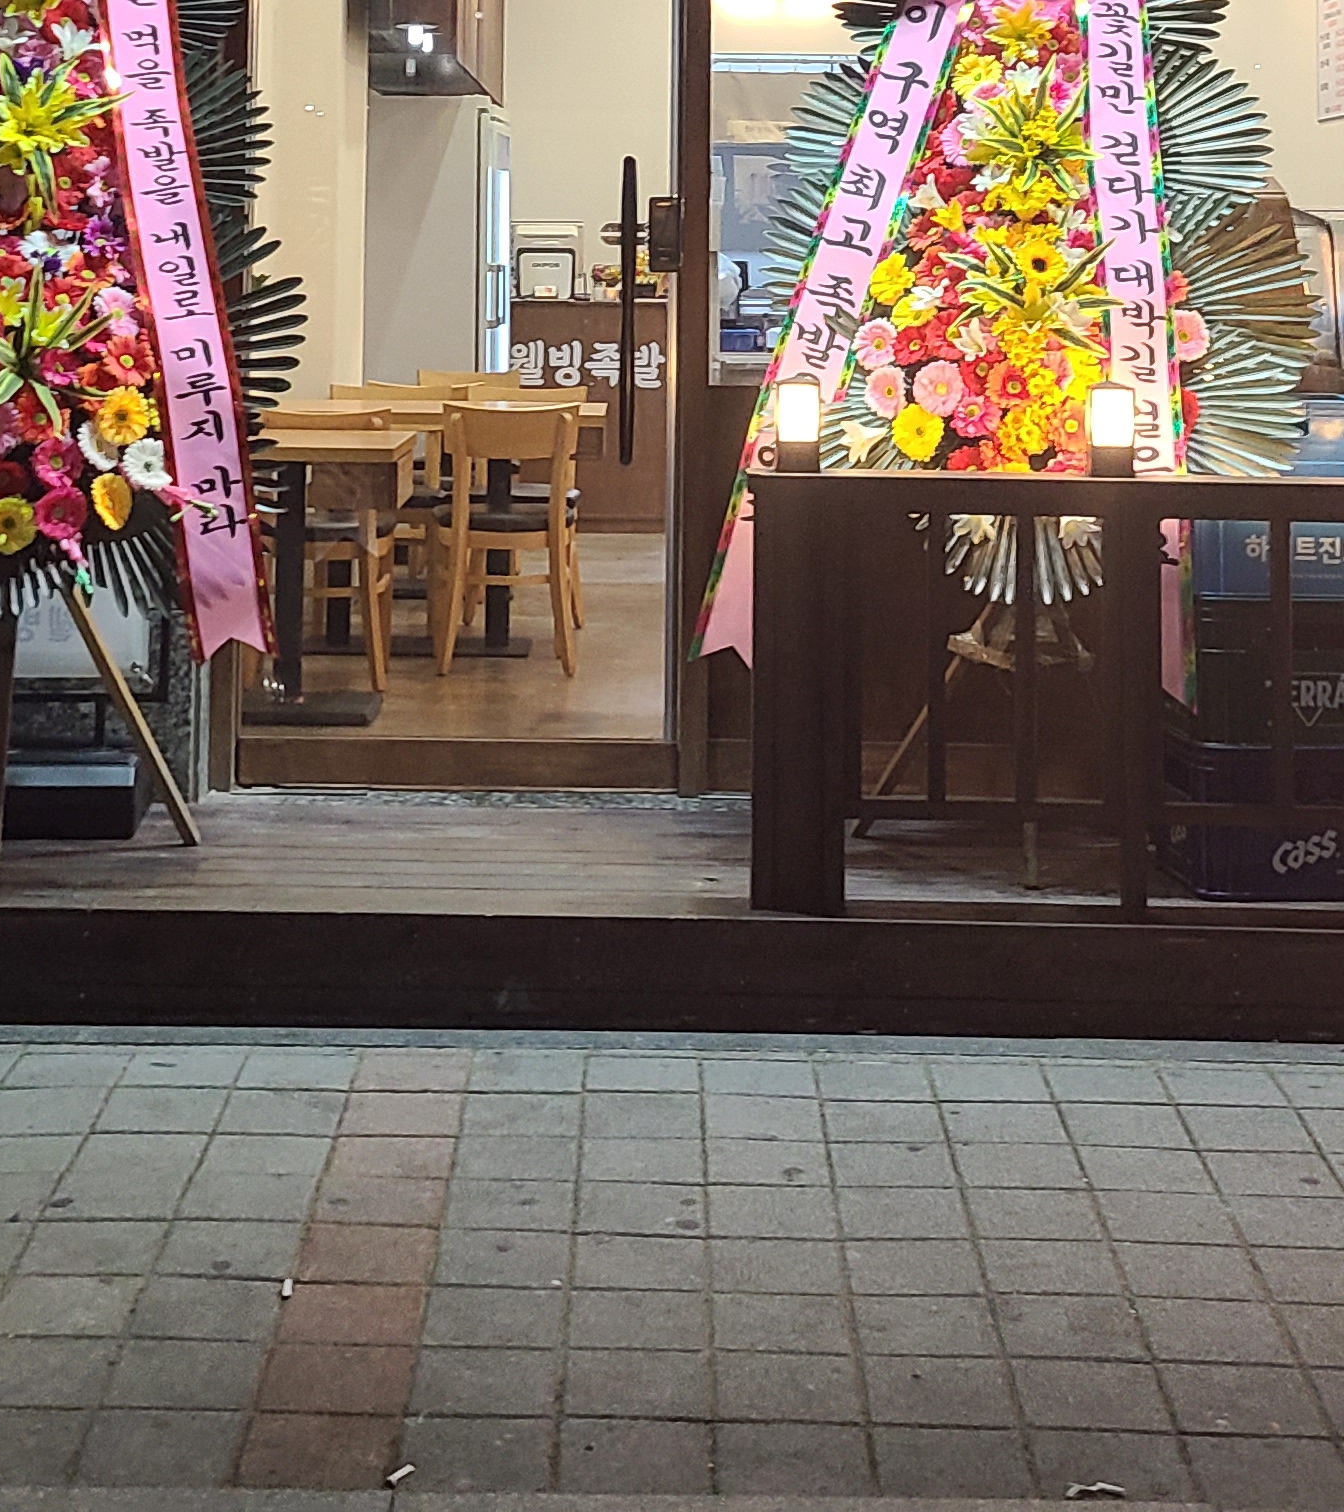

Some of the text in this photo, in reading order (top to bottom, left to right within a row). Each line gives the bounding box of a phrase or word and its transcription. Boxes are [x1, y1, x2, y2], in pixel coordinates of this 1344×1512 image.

[120, 25, 173, 91] 먹을
[1092, 2, 1147, 115] 꽃길만
[129, 108, 190, 206] 족발을
[1098, 130, 1161, 244] 걷다가
[821, 163, 888, 258] 최고
[151, 221, 215, 322] 내일로
[510, 338, 666, 389] 웰빙족발
[792, 274, 858, 371] 족발
[1109, 259, 1160, 384] 대박길
[169, 338, 229, 443] 미루지
[190, 465, 249, 540] 마라
